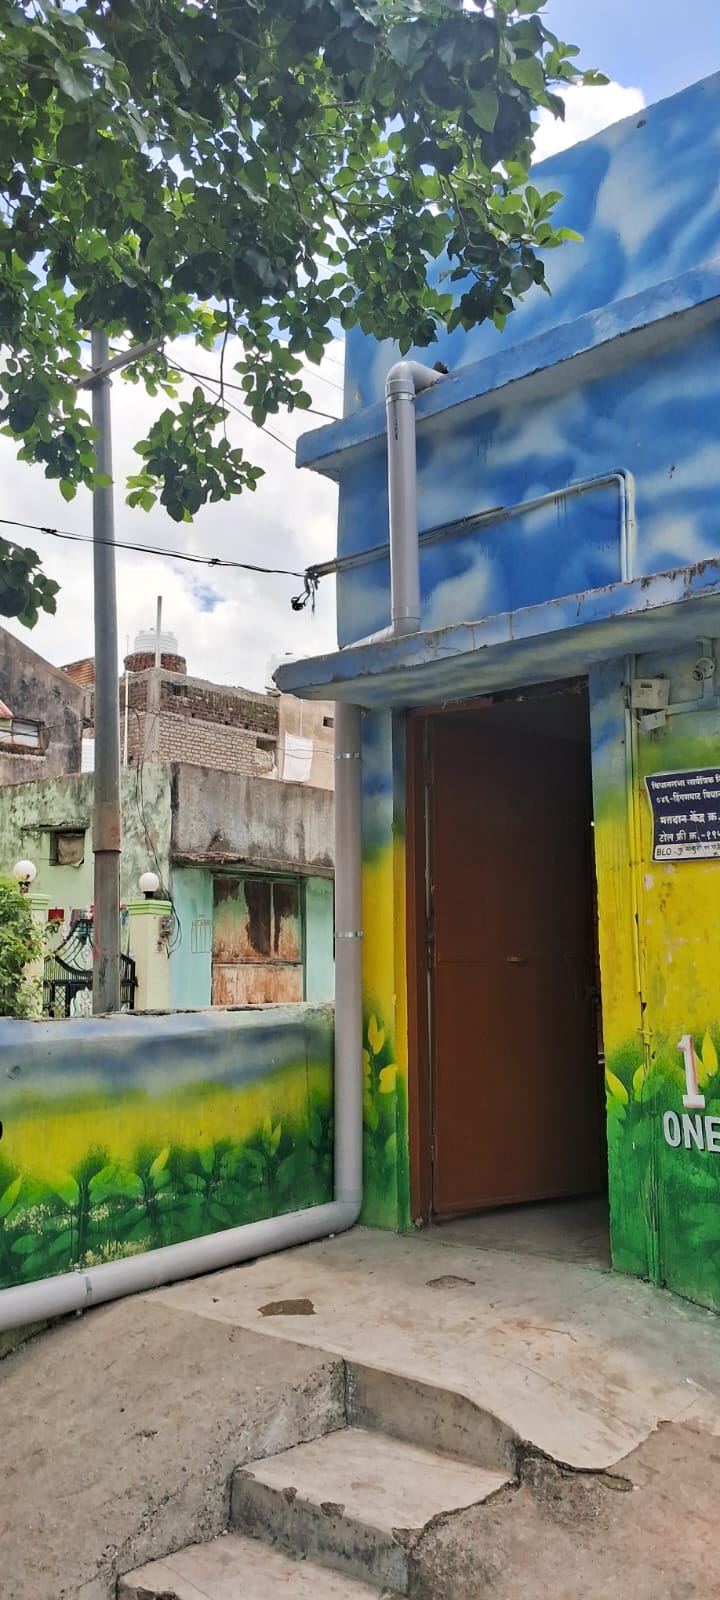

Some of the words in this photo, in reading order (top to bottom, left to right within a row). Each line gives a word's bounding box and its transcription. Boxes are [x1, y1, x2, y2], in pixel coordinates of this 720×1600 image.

[658, 831, 673, 842] टोल
[677, 1034, 706, 1109] 1
[662, 1110, 720, 1153] ONE
